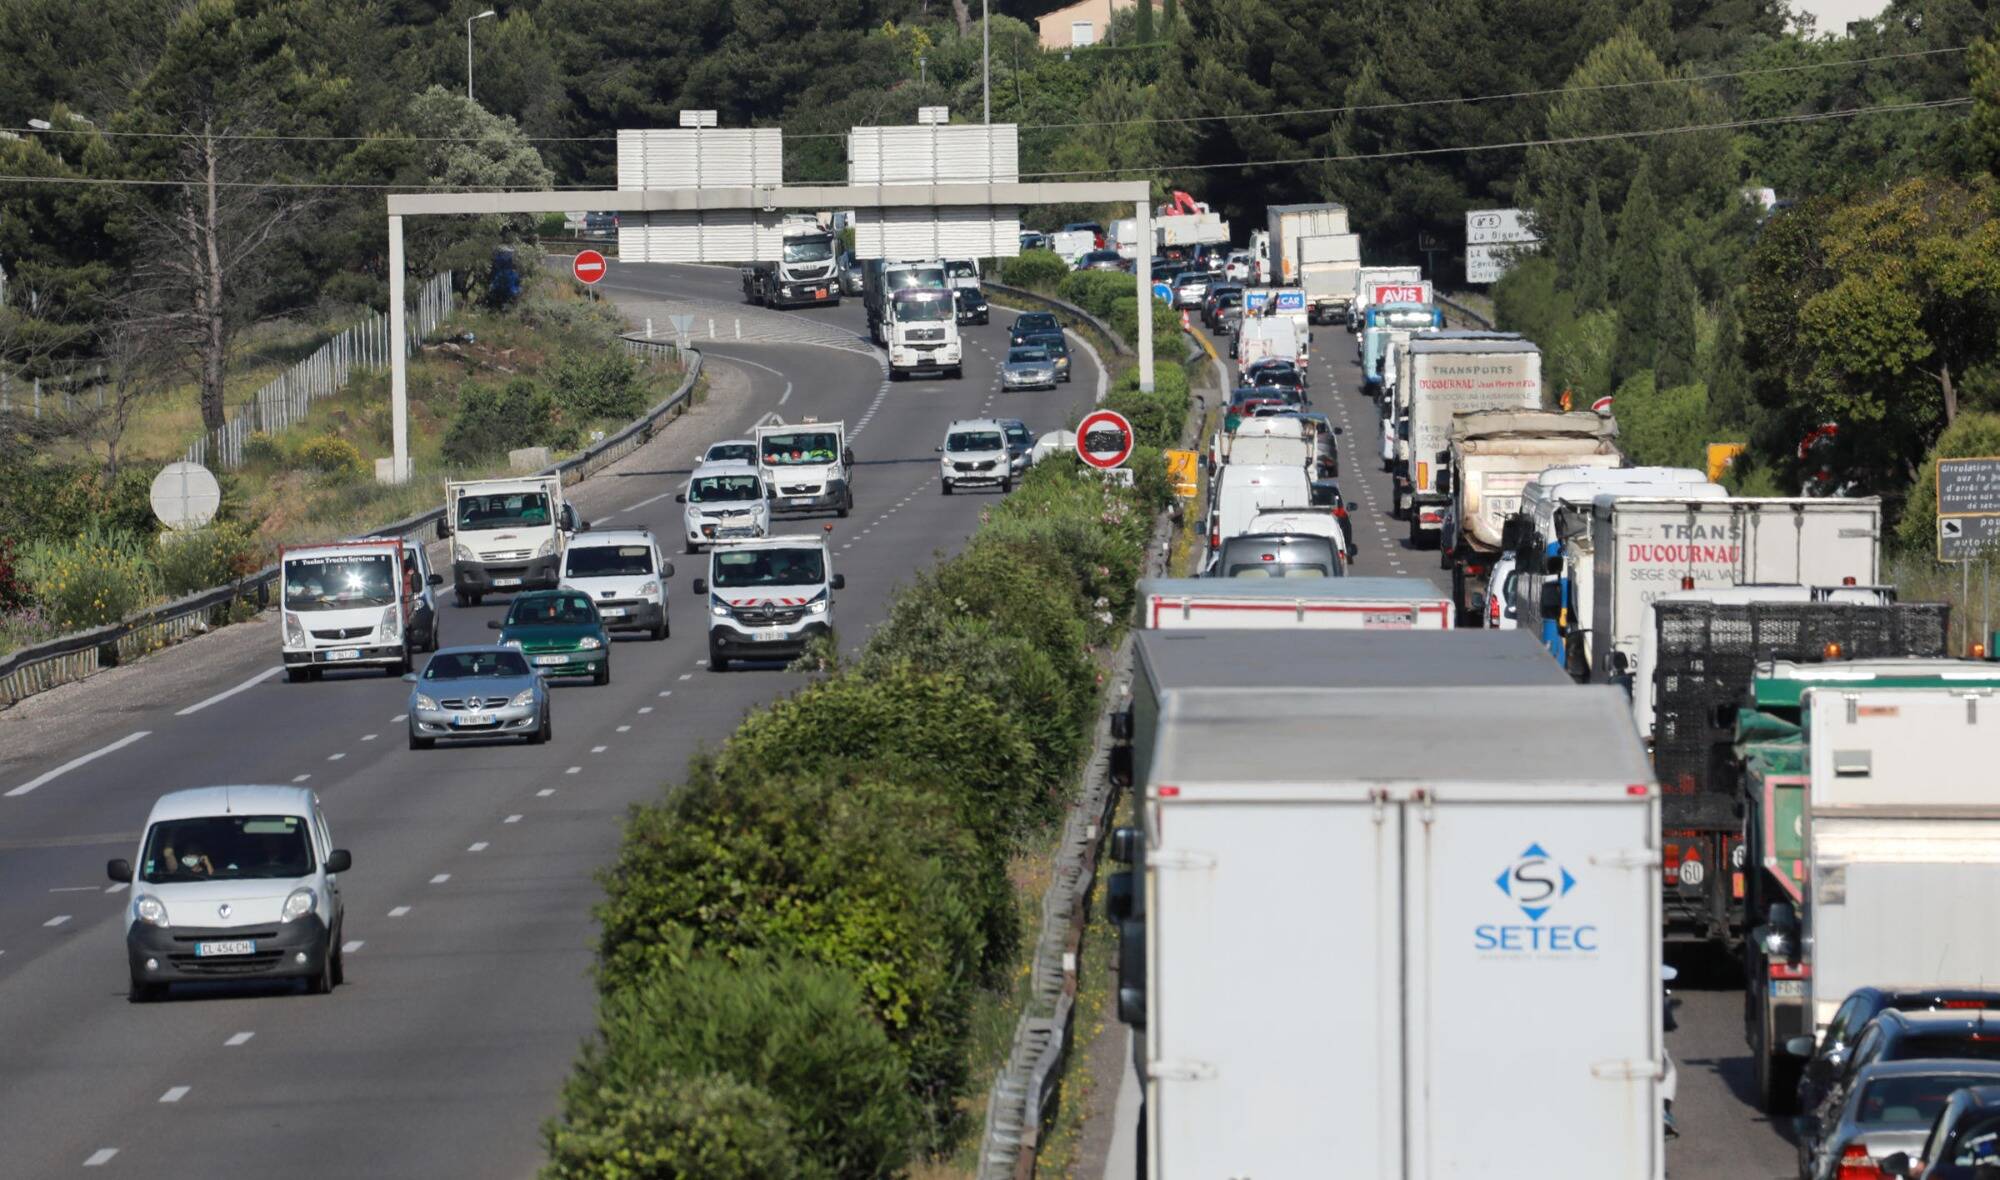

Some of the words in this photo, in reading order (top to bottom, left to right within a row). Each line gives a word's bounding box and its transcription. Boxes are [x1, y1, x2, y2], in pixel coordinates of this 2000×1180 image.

[1489, 217, 1495, 225] 5
[1281, 297, 1300, 305] CAR
[1382, 289, 1417, 304] AVIS
[1433, 366, 1513, 375] TRANSPORTS
[1661, 524, 1741, 540] TRANS
[1628, 544, 1740, 563] DUCOURNAU
[1630, 568, 1665, 581] SIEGE
[1668, 568, 1714, 581] SOCIAL
[1684, 863, 1700, 881] 60
[1515, 860, 1554, 902] S
[1475, 924, 1597, 950] SETEC
